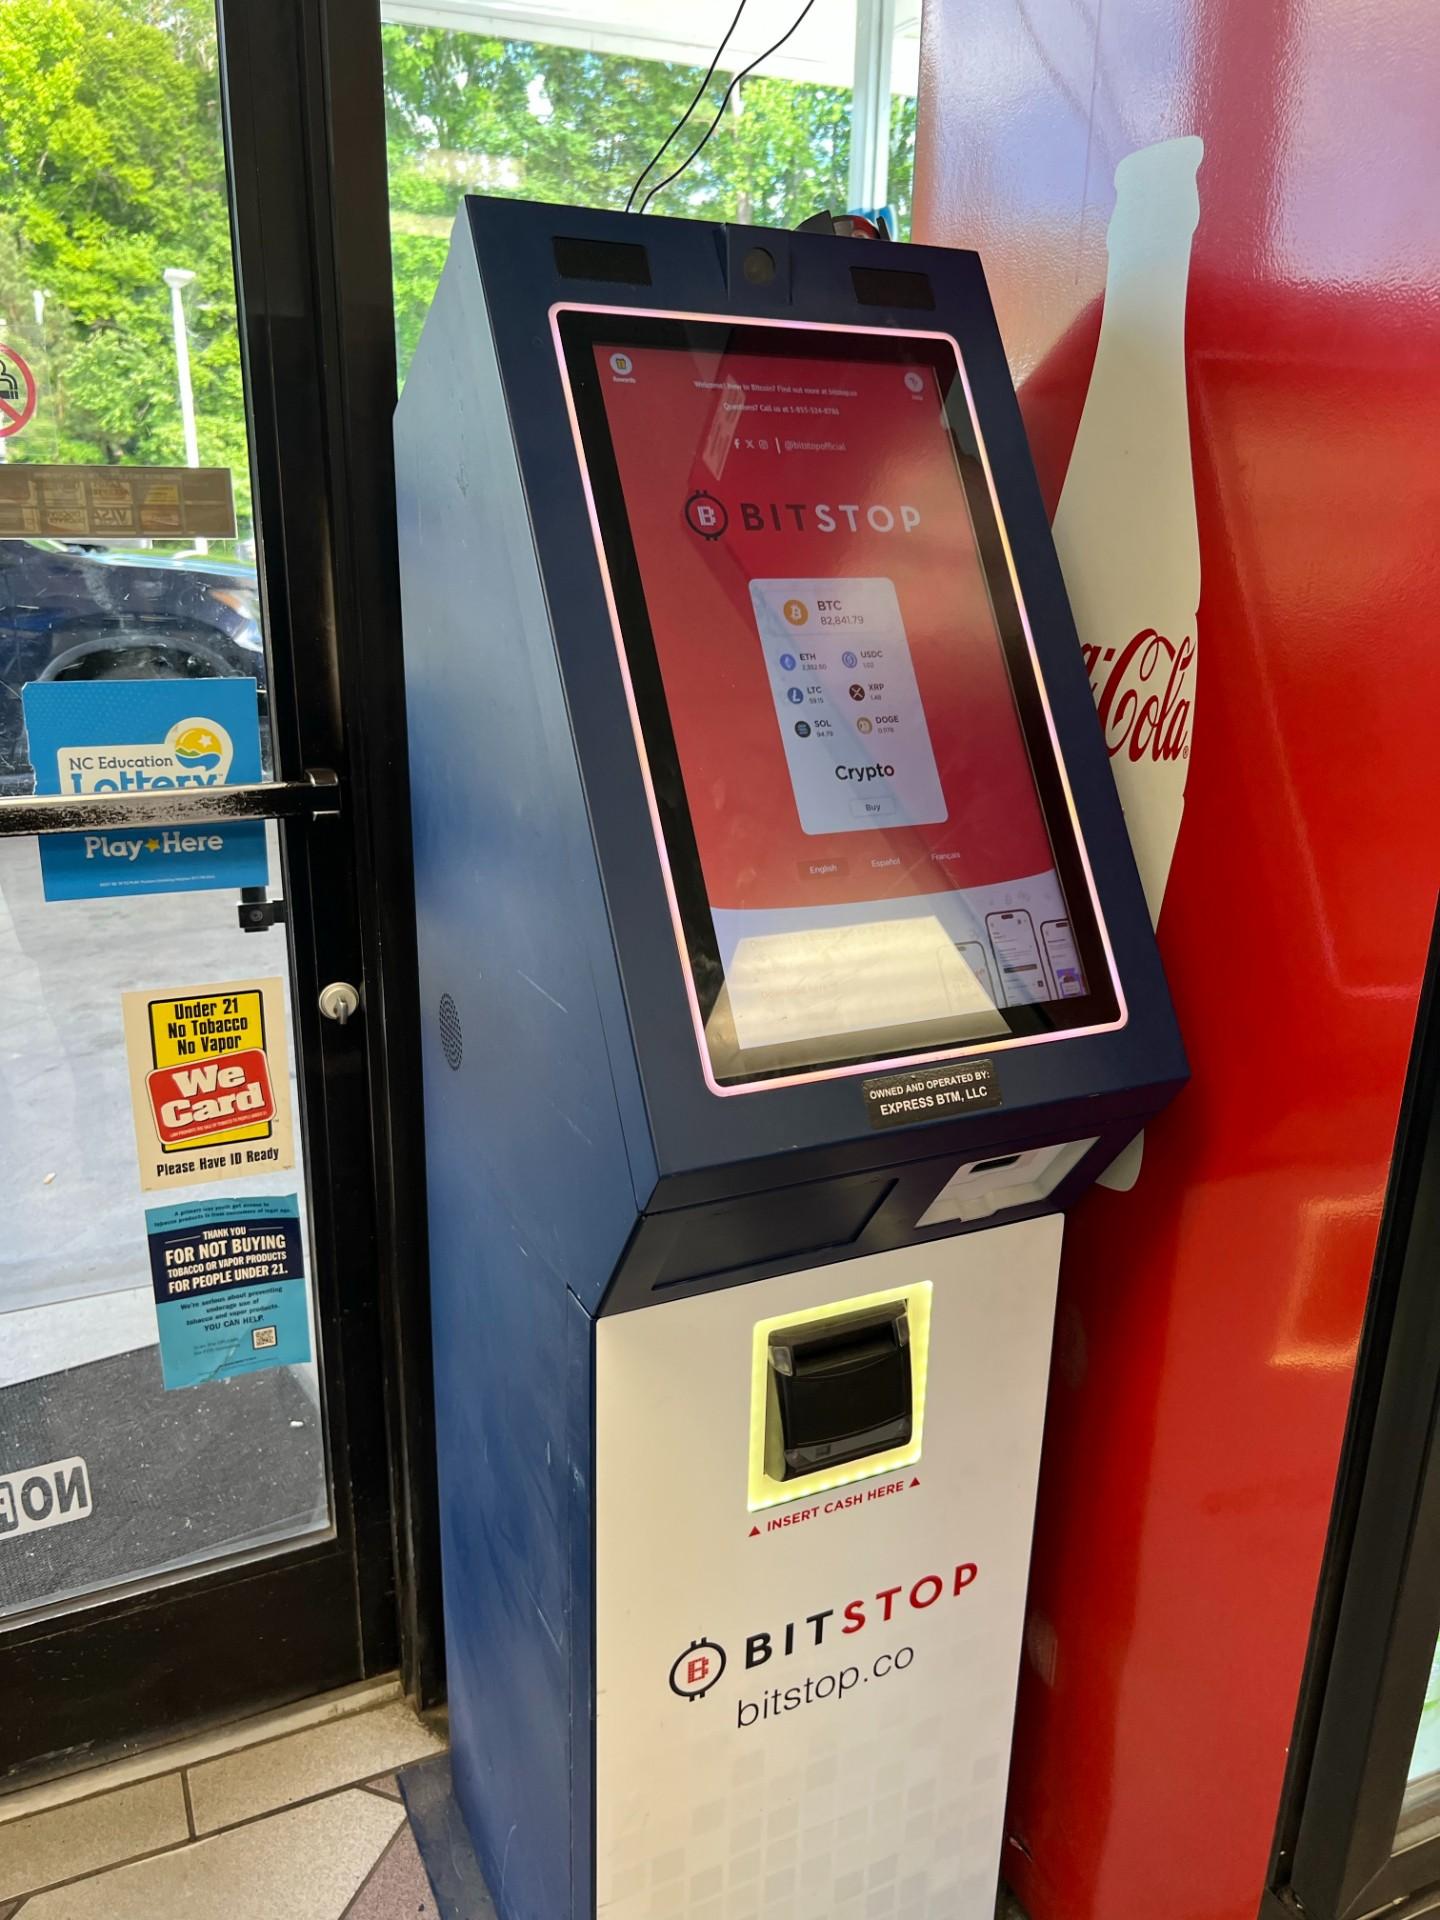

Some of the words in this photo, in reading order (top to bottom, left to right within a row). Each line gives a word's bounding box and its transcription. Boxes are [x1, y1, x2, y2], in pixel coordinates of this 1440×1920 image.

[740, 503, 921, 533] BITSTOP
[817, 600, 842, 611] BTC
[799, 653, 817, 661] ETH
[860, 650, 884, 658] USDC
[806, 686, 822, 695] LTC
[868, 683, 885, 691] XRP
[814, 719, 832, 728] SOL
[875, 715, 899, 724] DOGE
[69, 756, 94, 771] NC
[99, 755, 174, 770] Education
[835, 763, 895, 782] Crypto
[865, 803, 881, 813] Buy
[84, 836, 144, 861] Play
[162, 831, 224, 854] Here
[809, 863, 838, 875] English
[174, 1002, 217, 1020] Under
[223, 998, 239, 1015] 21
[168, 1022, 187, 1039] No
[192, 1017, 248, 1036] Tobacco
[178, 1039, 196, 1056] No
[200, 1035, 242, 1054] Vapor
[171, 1063, 246, 1098] We
[869, 1086, 904, 1100] OWNED
[905, 1082, 925, 1094] AND
[926, 1073, 974, 1089] OPERATED
[975, 1070, 991, 1081] BY:
[160, 1081, 265, 1129] Card
[880, 1095, 935, 1116] EXPRESS
[935, 1090, 965, 1106] BTM,
[965, 1086, 988, 1100] LLC
[156, 1160, 195, 1177] Please
[199, 1154, 226, 1171] Have
[230, 1152, 242, 1166] ID
[247, 1147, 279, 1164] Ready
[202, 1228, 229, 1240] THANK
[230, 1226, 247, 1237] YOU
[165, 1246, 195, 1266] FOR
[199, 1240, 228, 1260] NOT
[231, 1234, 286, 1254] BUYING
[167, 1263, 204, 1279] TOBACCO
[205, 1261, 218, 1272] OR
[218, 1256, 244, 1269] VAPOR
[245, 1251, 287, 1265] PRODUCTS
[168, 1278, 190, 1294] FOR
[192, 1270, 233, 1289] PEOPLE
[234, 1264, 269, 1281] UNDER
[270, 1263, 288, 1276] 21.
[227, 1292, 247, 1301] about
[203, 1322, 221, 1332] YOU
[223, 1319, 241, 1328] CAN
[767, 1506, 820, 1532] INSERT
[824, 1494, 863, 1514] CASH
[867, 1480, 904, 1501] HERE
[744, 1562, 978, 1669] BITSTOP
[737, 1646, 914, 1729] bitstop.co
